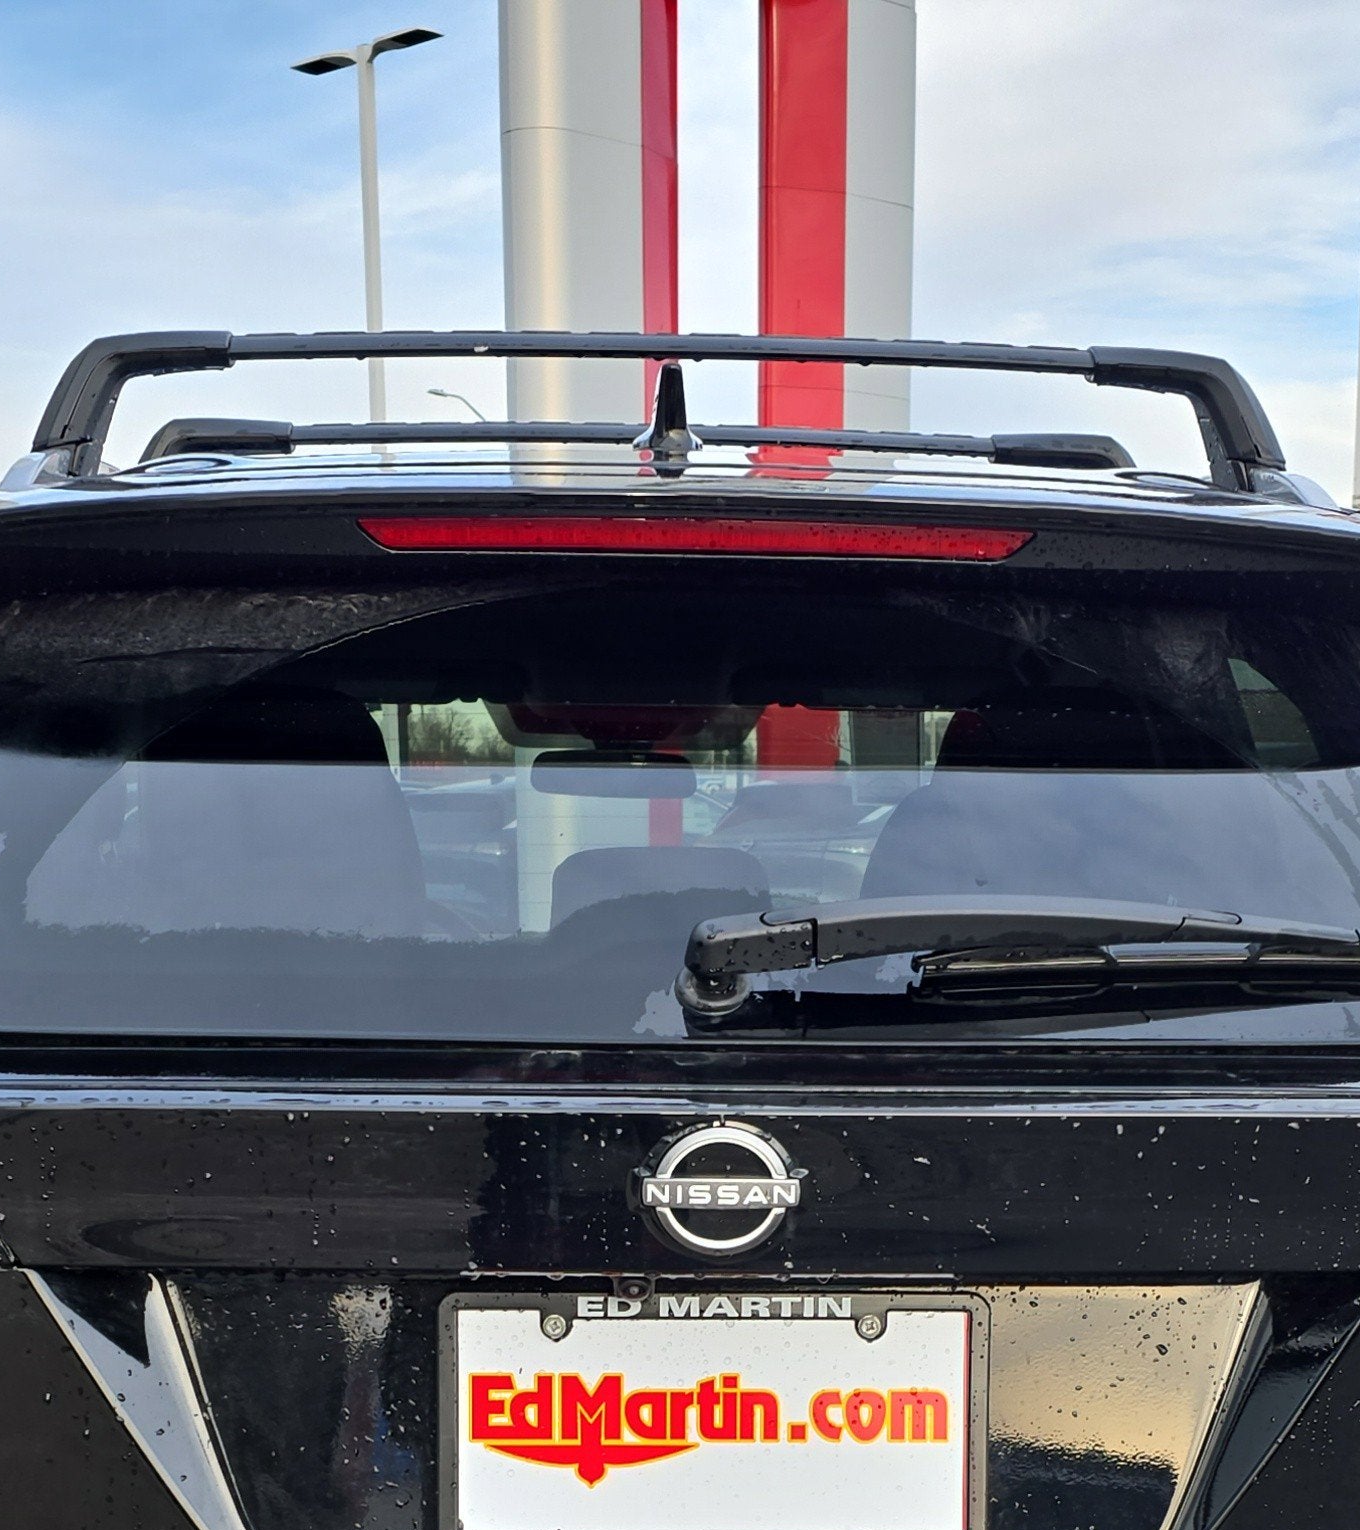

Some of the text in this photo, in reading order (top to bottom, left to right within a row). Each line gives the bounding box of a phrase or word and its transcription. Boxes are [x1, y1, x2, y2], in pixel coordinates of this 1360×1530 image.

[644, 1182, 798, 1205] NISSAN
[577, 1296, 852, 1318] ED MARTIN
